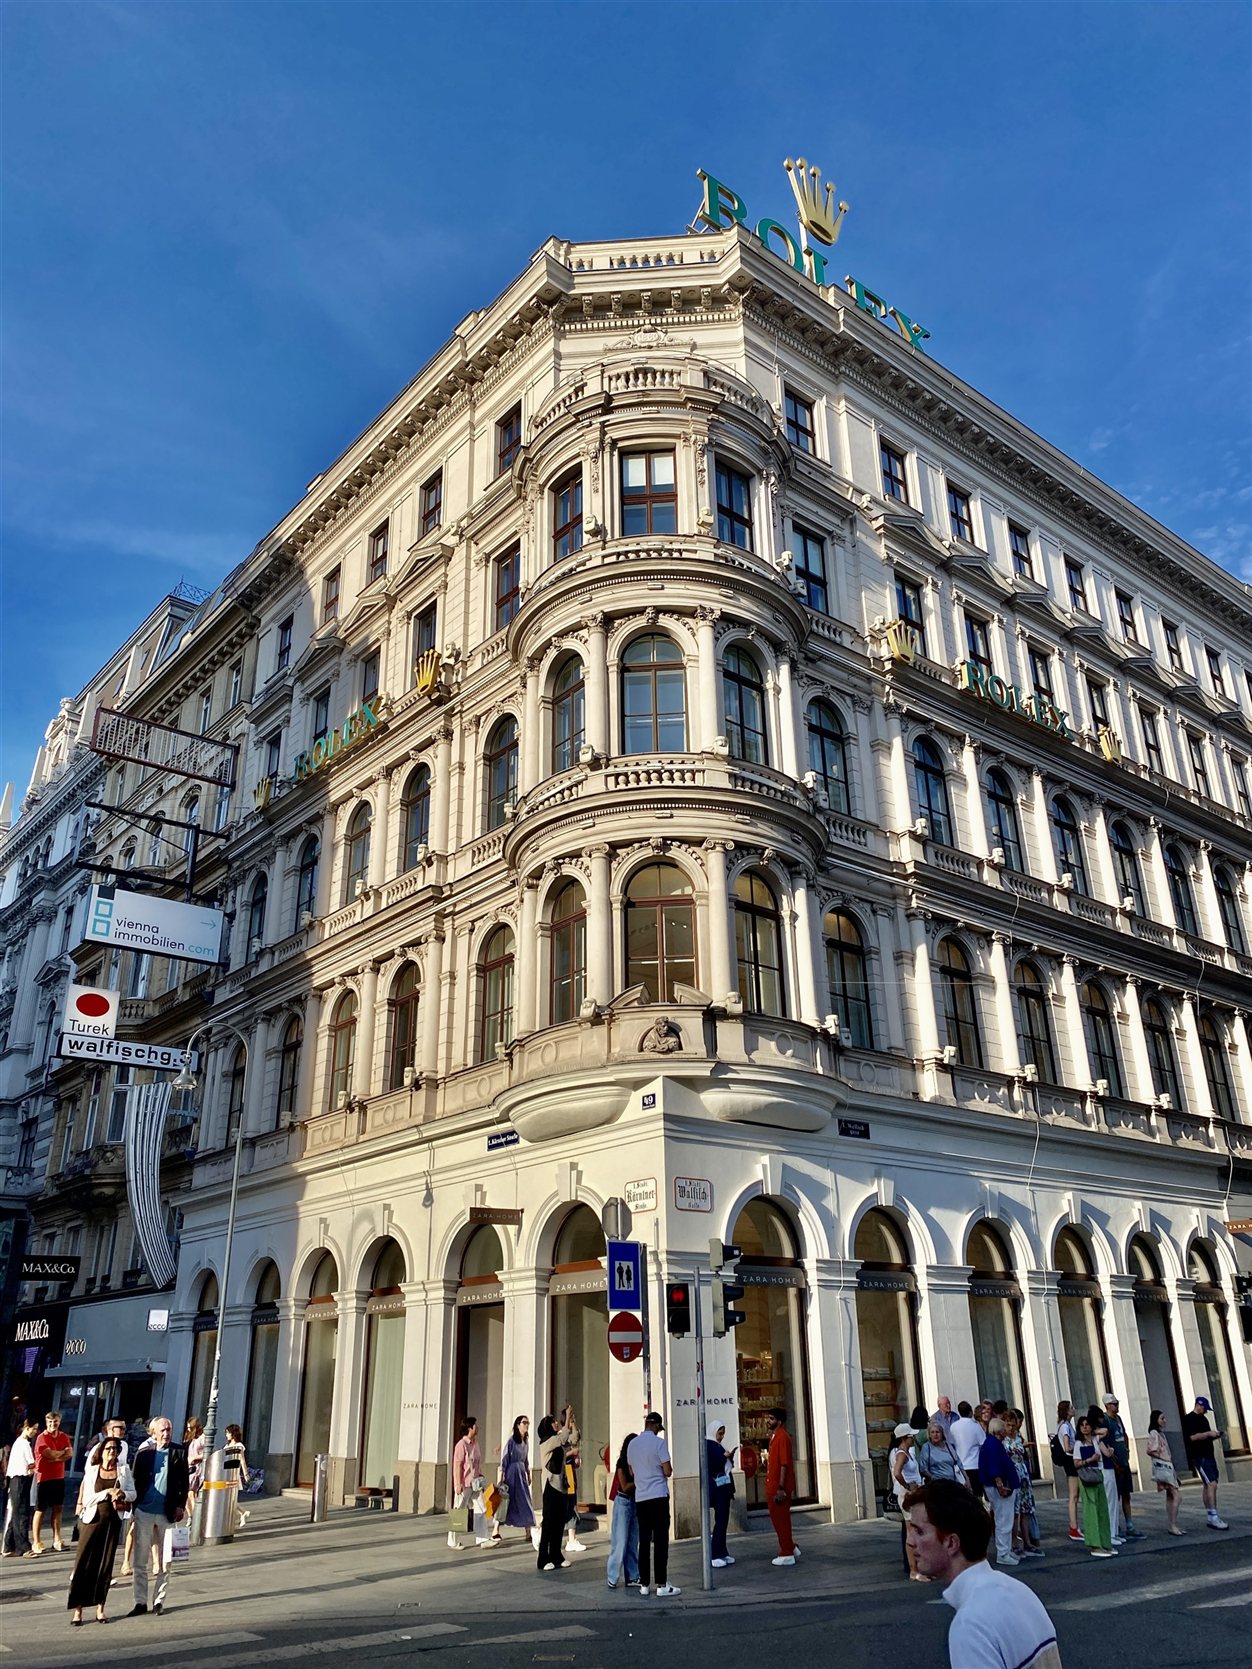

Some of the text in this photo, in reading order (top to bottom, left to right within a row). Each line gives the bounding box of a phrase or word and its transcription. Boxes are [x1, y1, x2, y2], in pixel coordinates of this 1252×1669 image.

[960, 659, 1075, 741] ROLEX
[293, 695, 382, 782] ROLEX
[116, 917, 160, 934] vienna
[114, 928, 215, 957] immobilien.com
[69, 1018, 110, 1036] Turek
[742, 1275, 797, 1285] ZARA HOME
[863, 1280, 909, 1289] ZARA HOME
[555, 1282, 604, 1292] ZARA HOME
[462, 1294, 480, 1303] ZARA
[371, 1303, 387, 1311] ZARA
[676, 1397, 734, 1407] ZAR HOME
